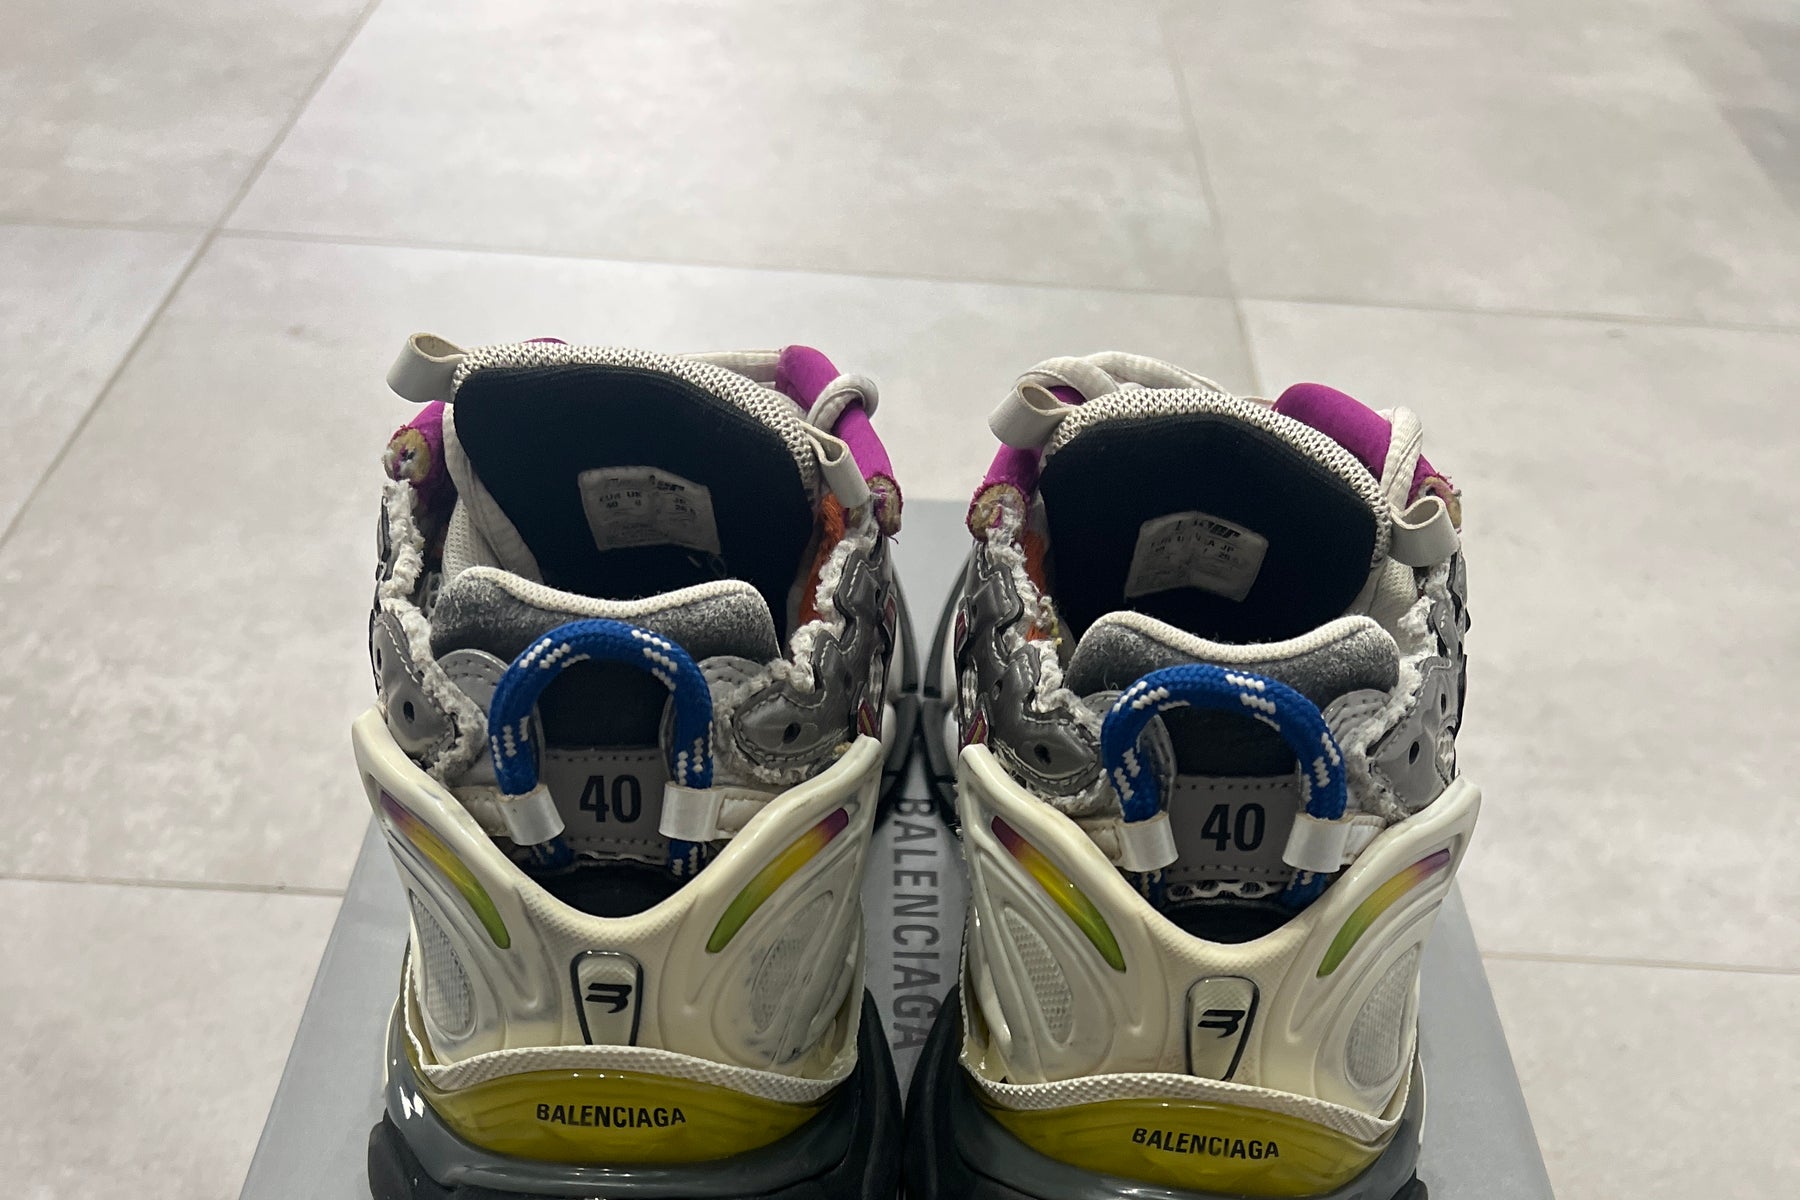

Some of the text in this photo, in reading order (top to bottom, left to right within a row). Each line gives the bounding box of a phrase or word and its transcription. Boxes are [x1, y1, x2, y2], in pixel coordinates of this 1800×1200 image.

[578, 774, 642, 824] 40
[1201, 803, 1266, 852] 40
[893, 797, 941, 1051] BALENCIAGA
[536, 1103, 687, 1129] BALENCIAGA
[1131, 1127, 1280, 1160] BALENCIAGA
